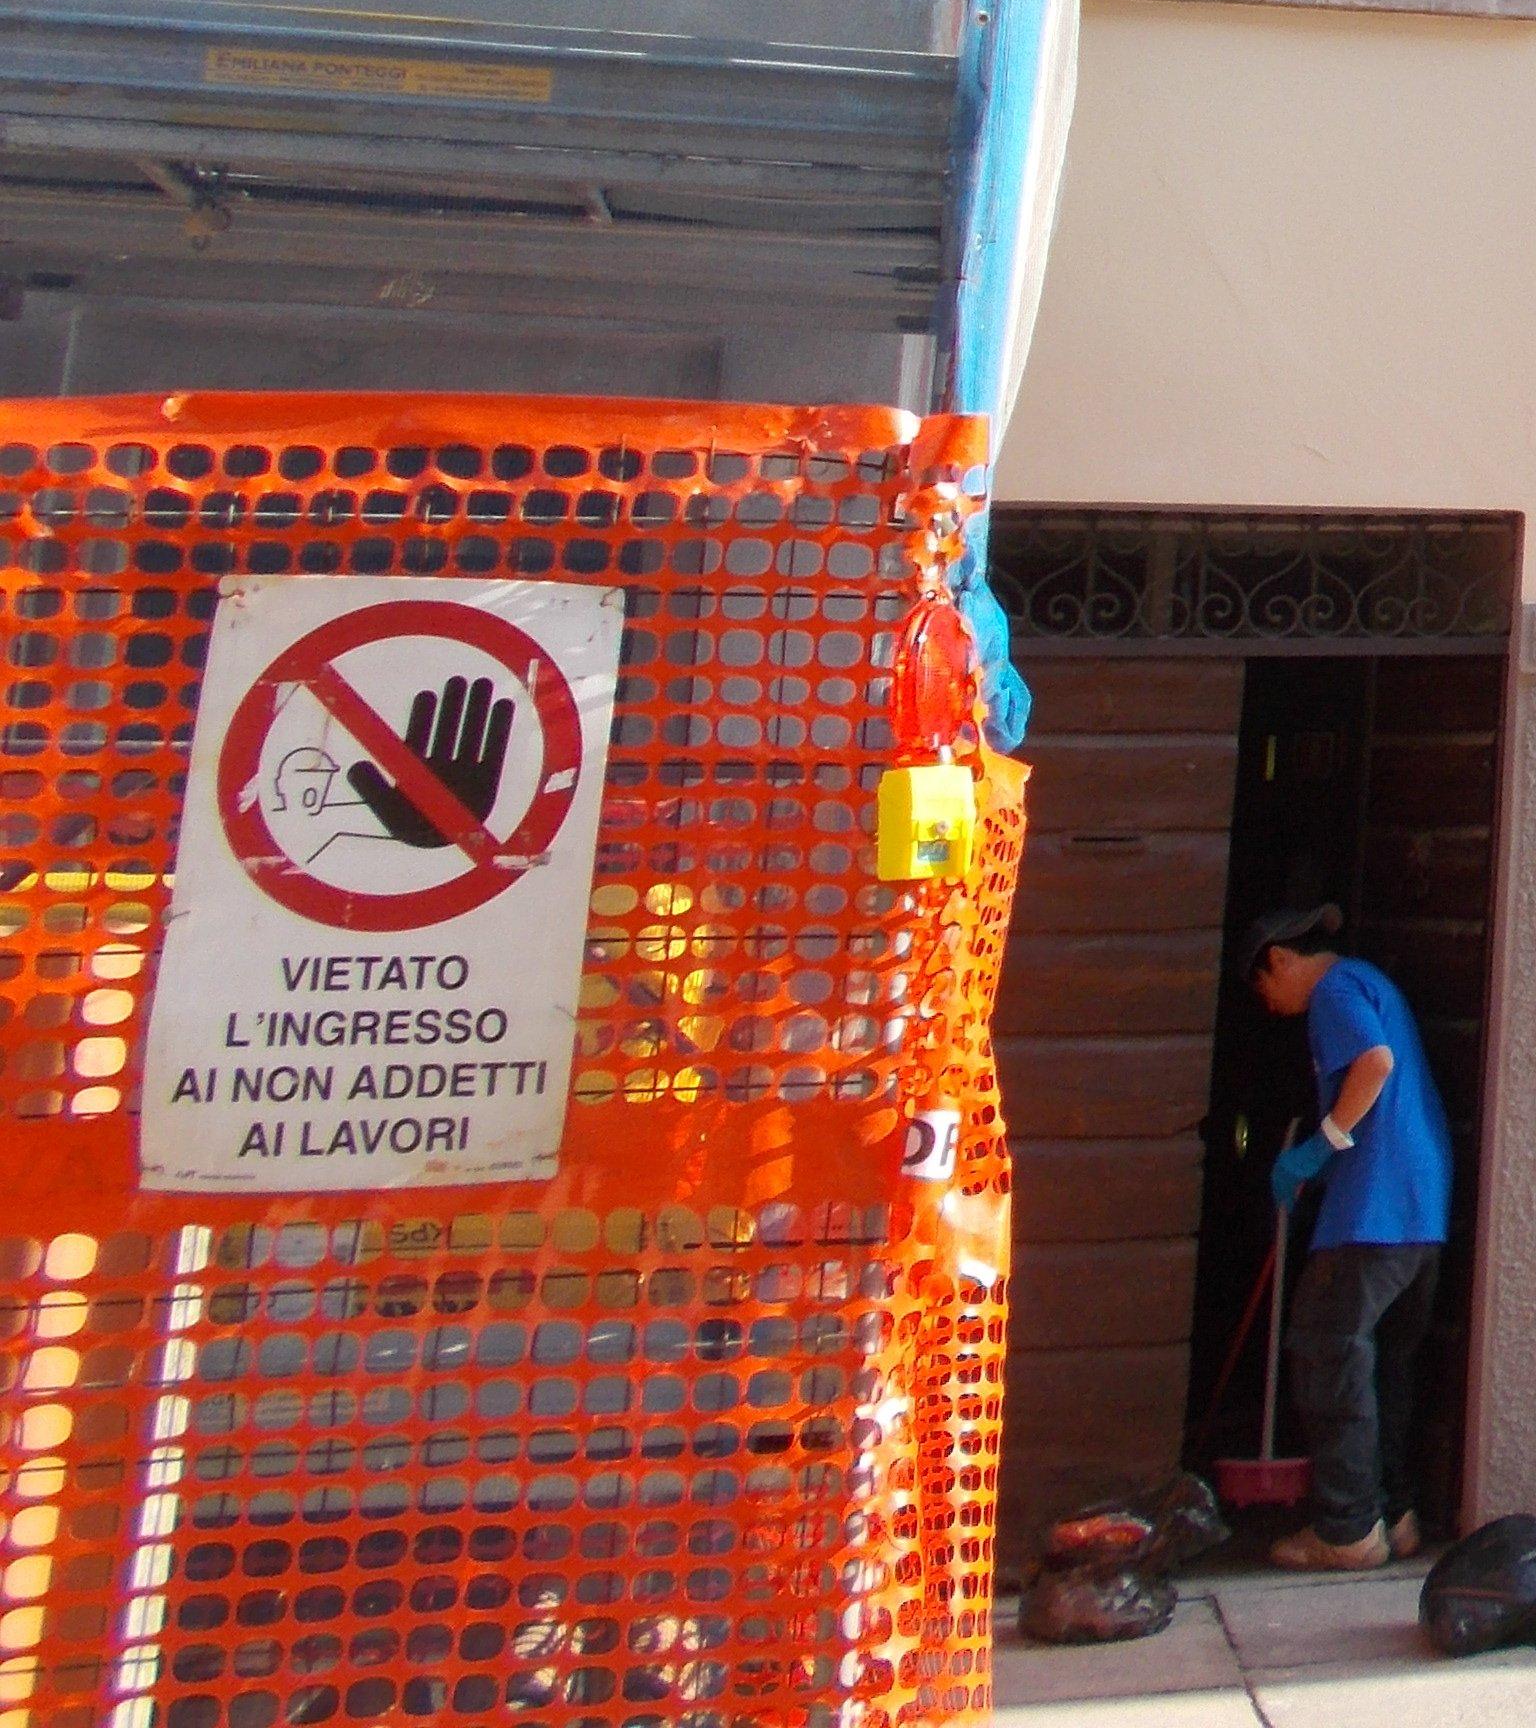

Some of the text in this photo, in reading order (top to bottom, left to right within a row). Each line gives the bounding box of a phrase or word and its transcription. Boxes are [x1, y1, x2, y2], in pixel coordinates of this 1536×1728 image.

[281, 955, 469, 992] VIETATO
[225, 1008, 508, 1048] L'INGRESSO
[172, 1061, 547, 1104] AI NON ADDETTI
[238, 1117, 469, 1158] AI LAVORI
